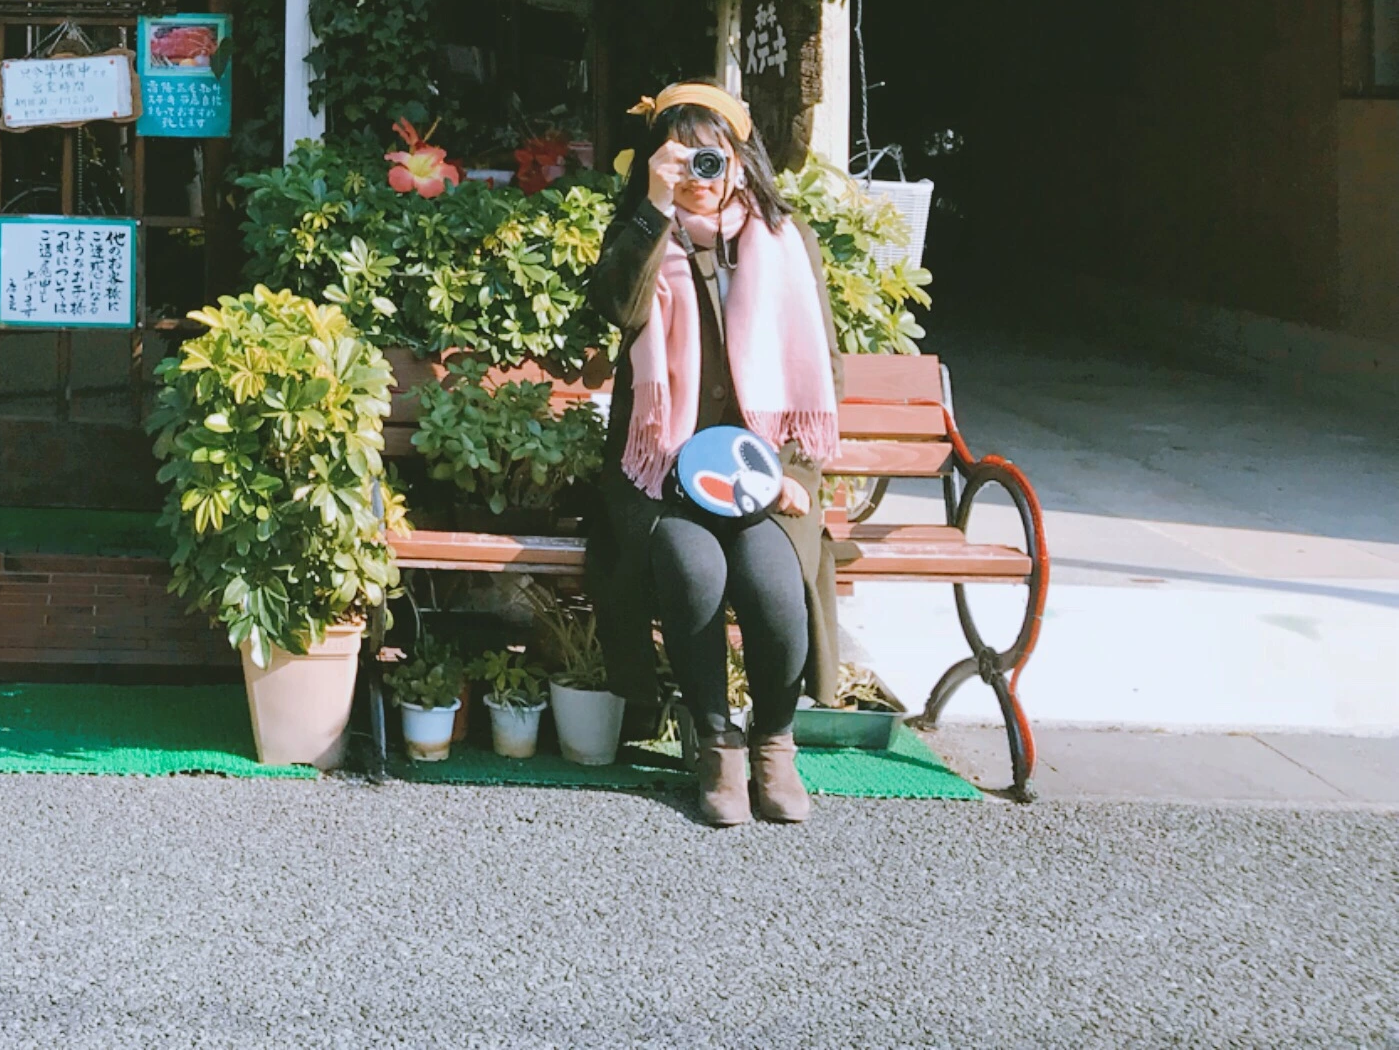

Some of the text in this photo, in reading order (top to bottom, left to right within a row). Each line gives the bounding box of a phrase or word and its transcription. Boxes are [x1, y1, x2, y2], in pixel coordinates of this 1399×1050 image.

[754, 0, 777, 31] 和牛
[745, 24, 788, 79] ステーキ
[105, 231, 126, 311] 他のお客様に
